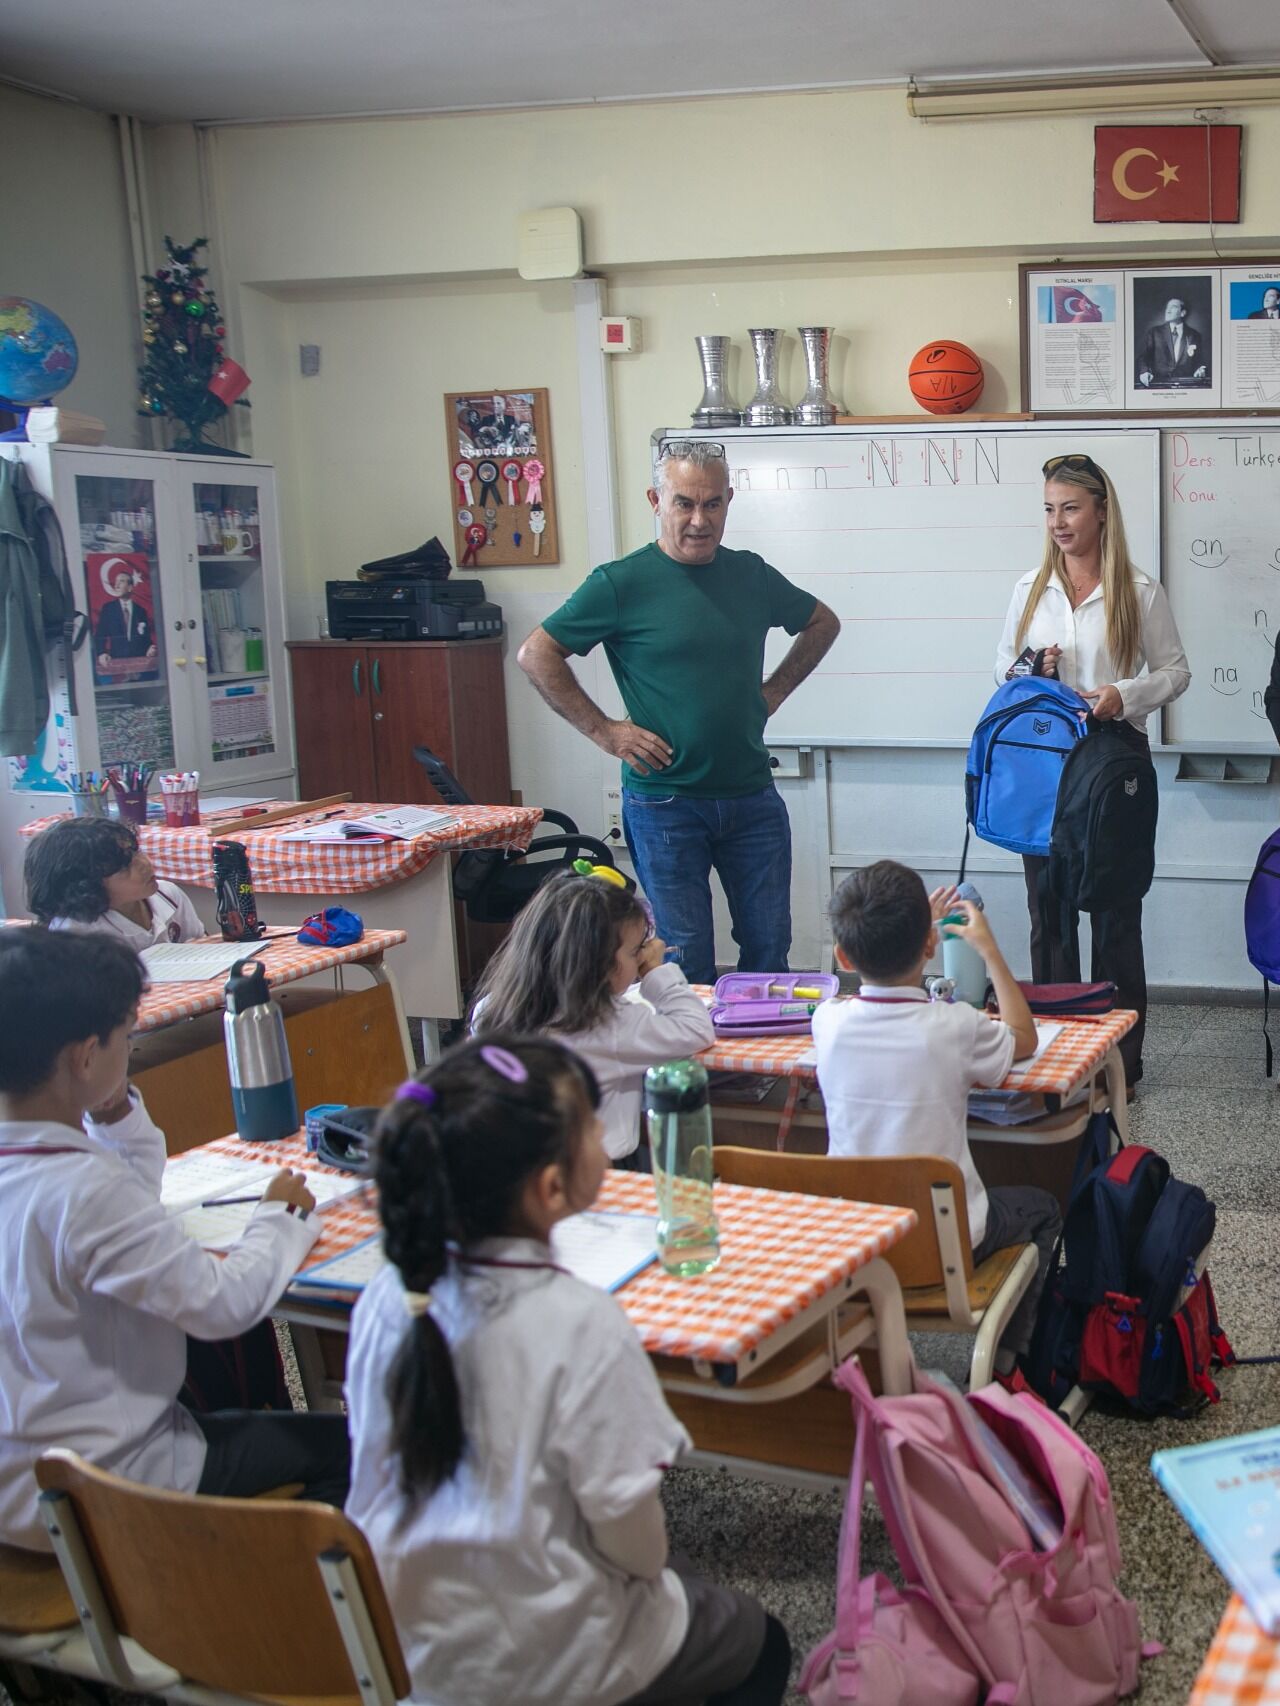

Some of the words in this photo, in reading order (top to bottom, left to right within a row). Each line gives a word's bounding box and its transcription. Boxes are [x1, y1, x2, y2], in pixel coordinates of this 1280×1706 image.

[975, 437, 1000, 485] N
[1191, 537, 1223, 556] an
[1213, 665, 1238, 684] na
